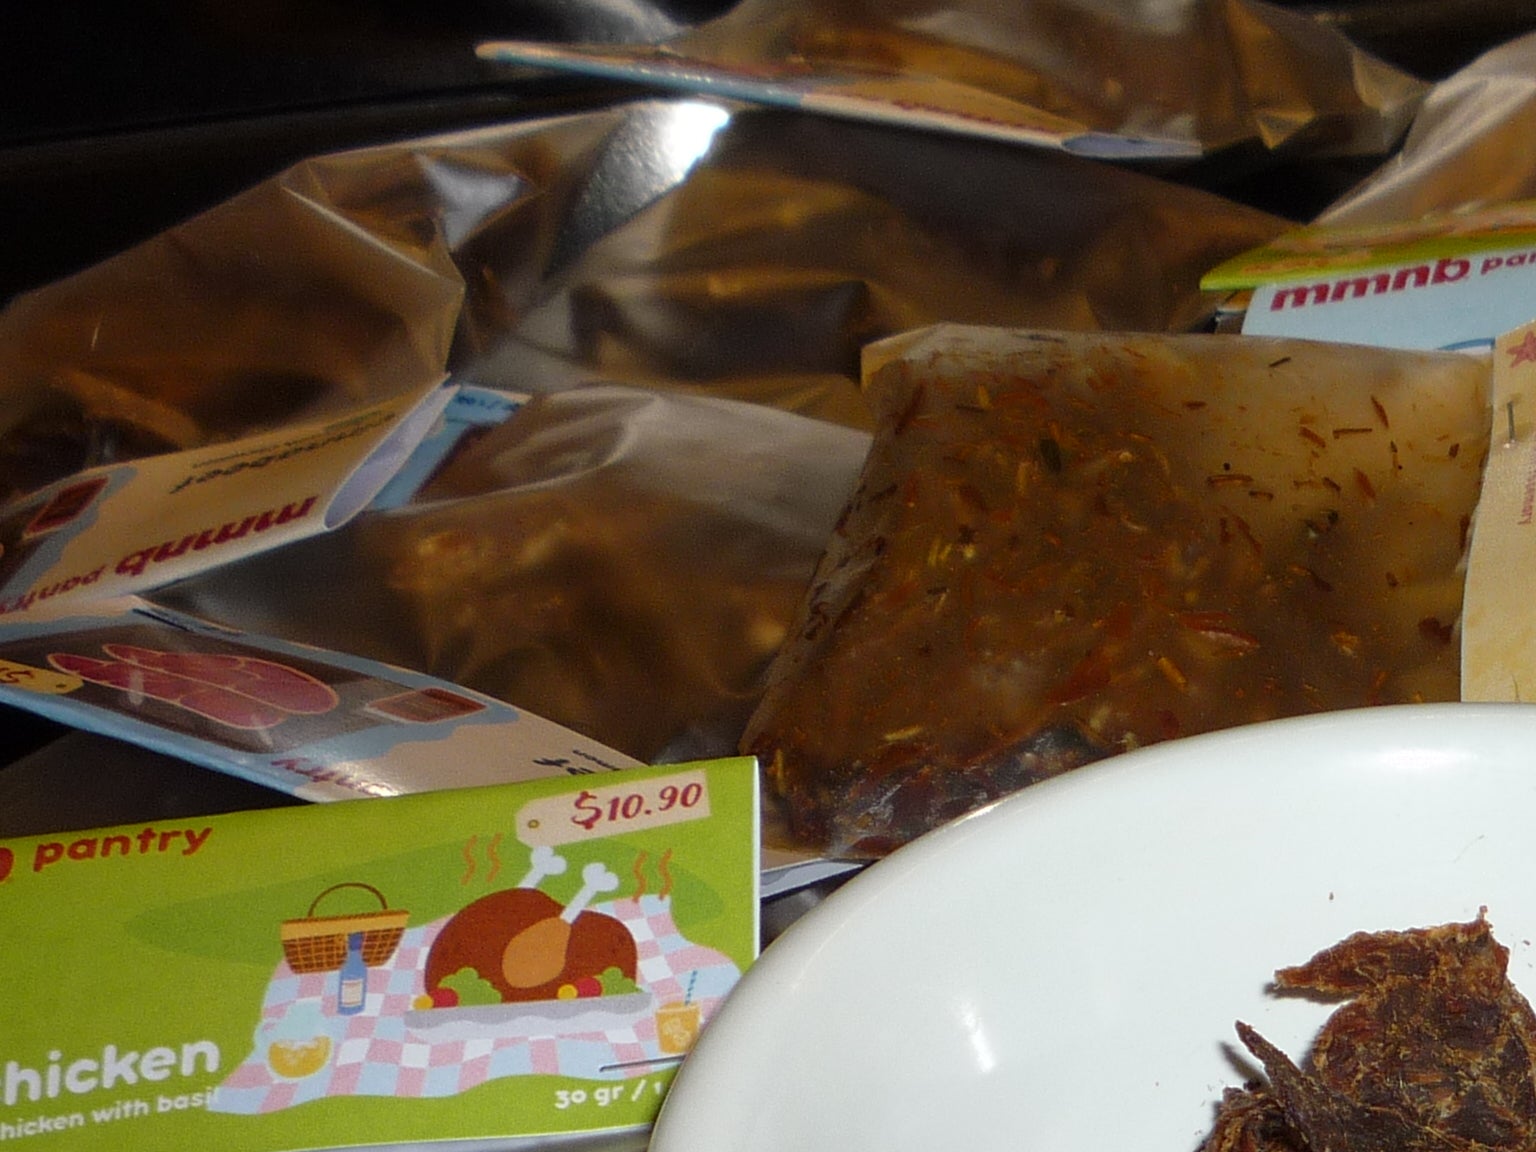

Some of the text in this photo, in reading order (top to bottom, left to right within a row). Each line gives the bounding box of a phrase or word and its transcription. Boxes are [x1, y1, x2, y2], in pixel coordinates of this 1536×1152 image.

[1269, 257, 1472, 312] mmnb
[571, 782, 704, 830] $10.90
[33, 827, 213, 872] pantry
[0, 1040, 220, 1106] hicken
[0, 1113, 84, 1140] hicken
[91, 1099, 149, 1124] with
[554, 1089, 587, 1109] 30
[593, 1085, 624, 1107] gr
